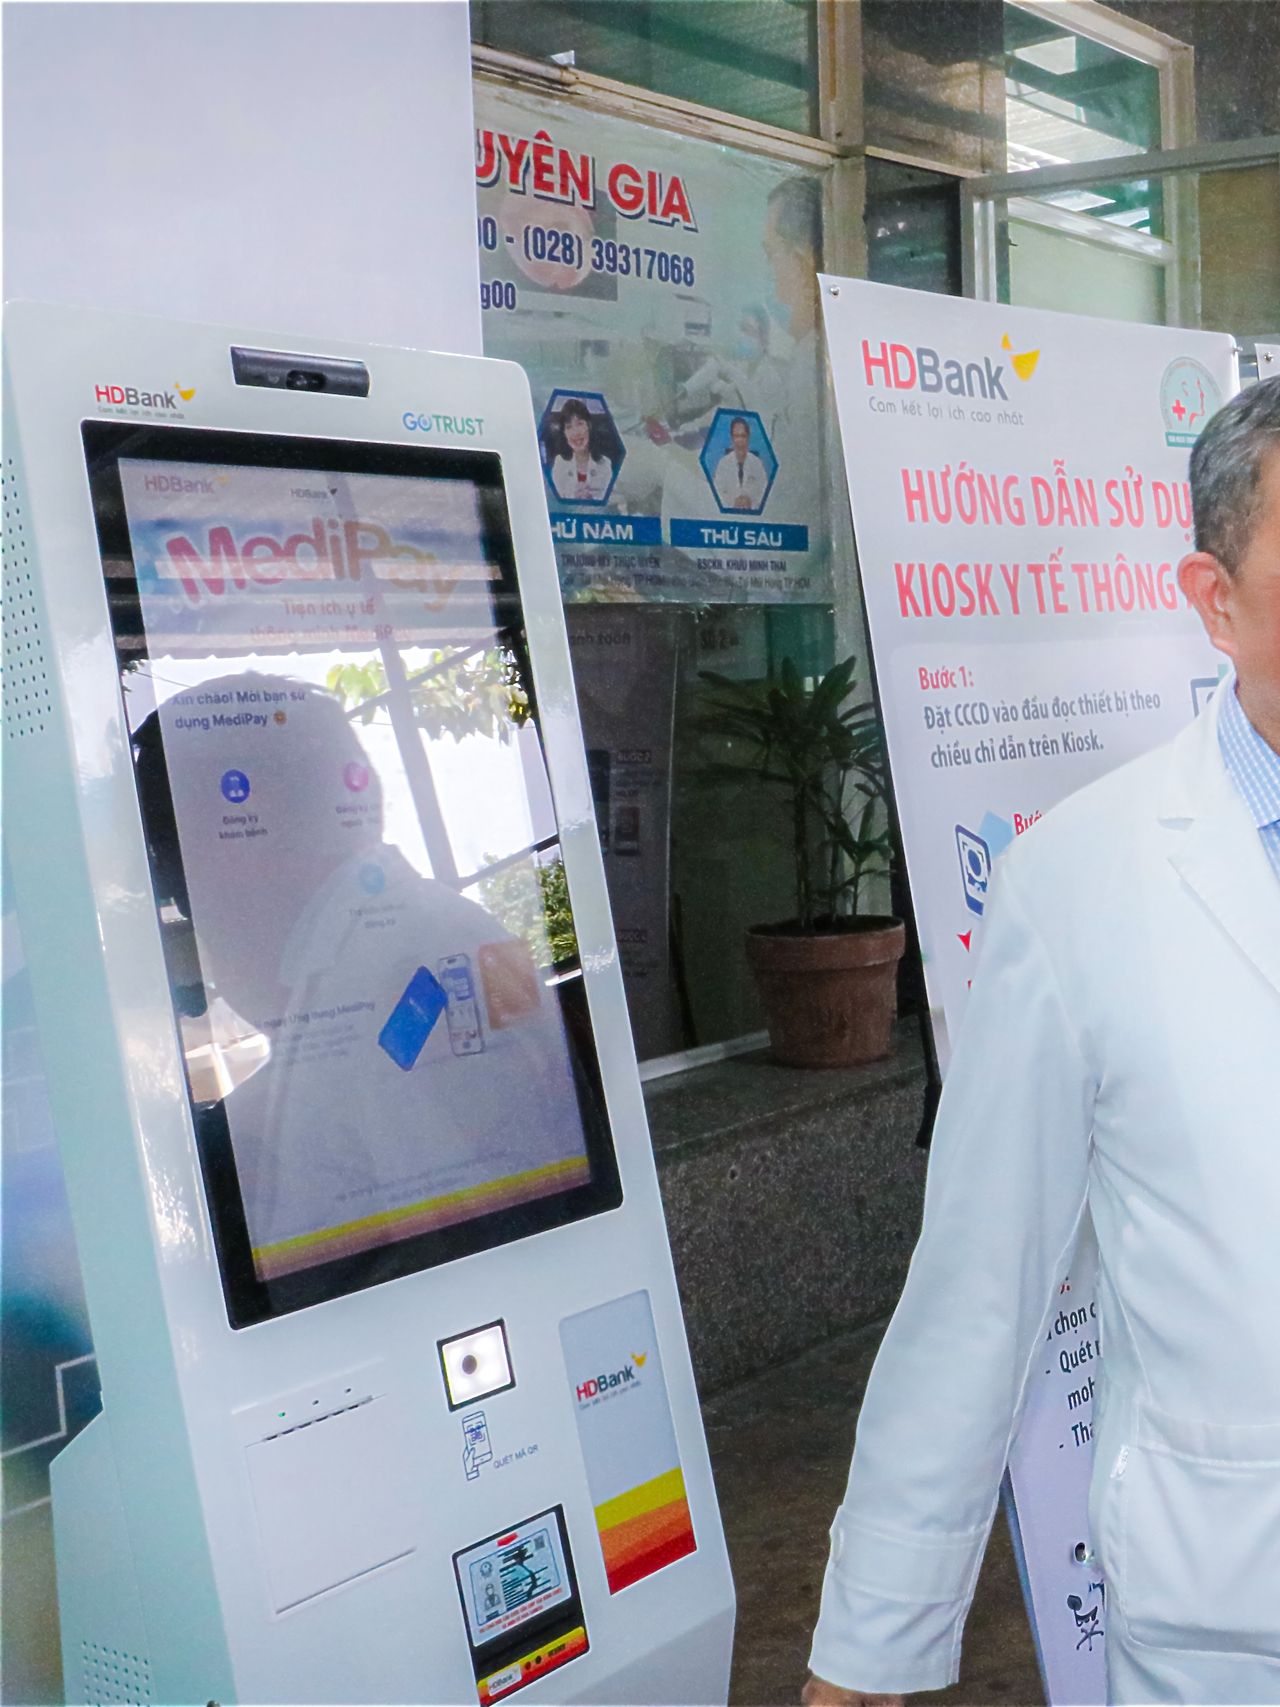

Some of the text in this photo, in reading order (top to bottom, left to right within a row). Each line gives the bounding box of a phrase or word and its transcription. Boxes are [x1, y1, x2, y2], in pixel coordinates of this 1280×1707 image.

[607, 162, 697, 231] GIA
[523, 225, 583, 270] (028)
[591, 238, 695, 287] 39317068
[862, 339, 1009, 401] HDBank
[95, 384, 178, 410] HDBank
[869, 396, 897, 414] Cam
[901, 399, 923, 417] kết
[971, 411, 992, 423] cao
[402, 412, 484, 436] GOTRUST
[144, 475, 215, 494] HDBank
[901, 461, 1026, 527] HƯỚNG
[1031, 459, 1100, 528] DẪN
[1104, 465, 1144, 529] SỬ
[582, 520, 634, 541] NĂM
[700, 525, 782, 547] THỨ SÁU
[166, 516, 459, 613] MediPay
[894, 546, 1177, 618] KIOSK Y TẾ THÔNG
[918, 666, 975, 691] Bước 1:
[212, 712, 269, 728] MediPay
[923, 689, 1161, 735] Đặt CCCD vào đầu đọc thiết bị theo
[931, 729, 1105, 769] chiều chỉ dẫn trên Kiosk.
[1059, 1339, 1094, 1374] Quét
[576, 1364, 635, 1402] HDBank
